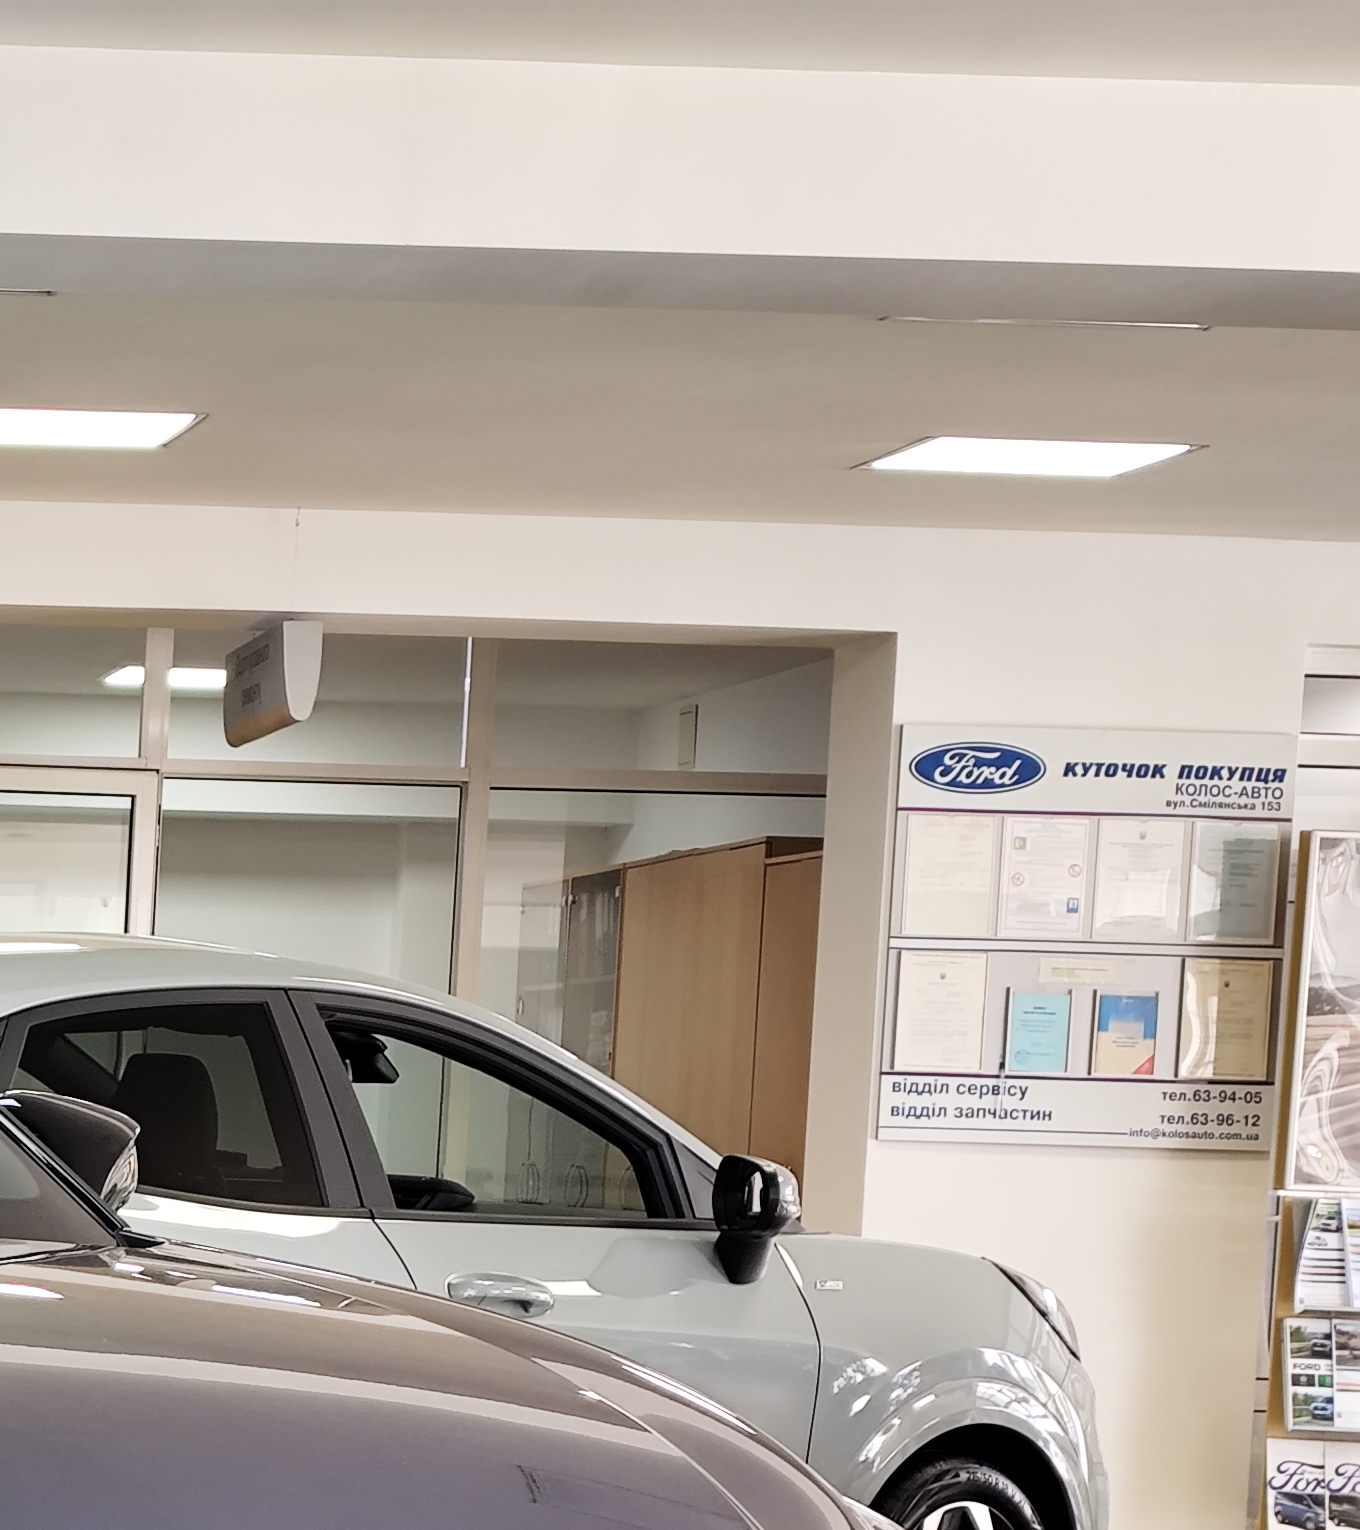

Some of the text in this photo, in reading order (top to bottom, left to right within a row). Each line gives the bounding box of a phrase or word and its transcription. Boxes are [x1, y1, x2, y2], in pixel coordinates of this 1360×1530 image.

[934, 749, 1023, 785] Ford
[1062, 761, 1288, 785] КУТОЧОК ПОКУПЦЯ
[1175, 782, 1285, 800] КОЛОС-АВТО
[1165, 798, 1282, 812] вул.Смілянська 153
[891, 1078, 1030, 1101] відділ сервісу
[1161, 1089, 1264, 1105] тел.63-94-05
[890, 1102, 1053, 1121] відділ запчастин
[1158, 1112, 1262, 1128] тел.63-96-12
[1128, 1127, 1260, 1141] info@kolosauto.com.ua
[1292, 1362, 1322, 1371] FORD
